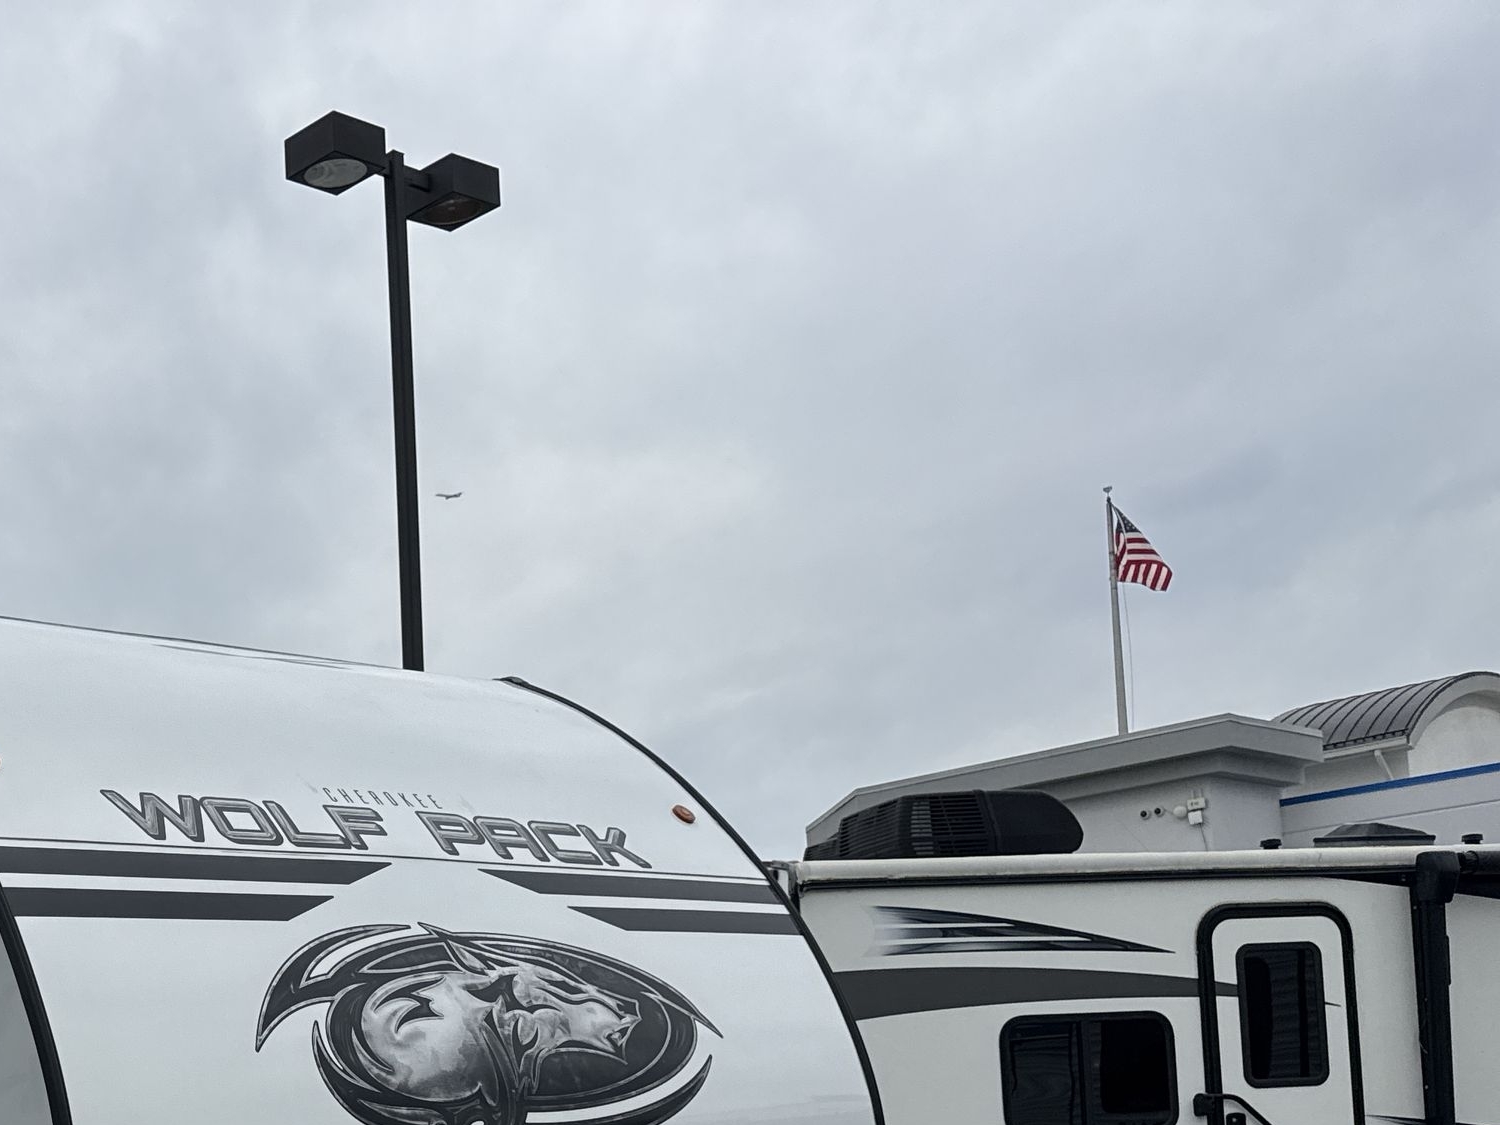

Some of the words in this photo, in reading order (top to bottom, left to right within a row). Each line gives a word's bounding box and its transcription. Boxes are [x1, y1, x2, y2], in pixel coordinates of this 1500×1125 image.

[321, 786, 445, 811] CHEROKEE
[99, 789, 388, 851] WOLF
[415, 809, 653, 869] PACK
